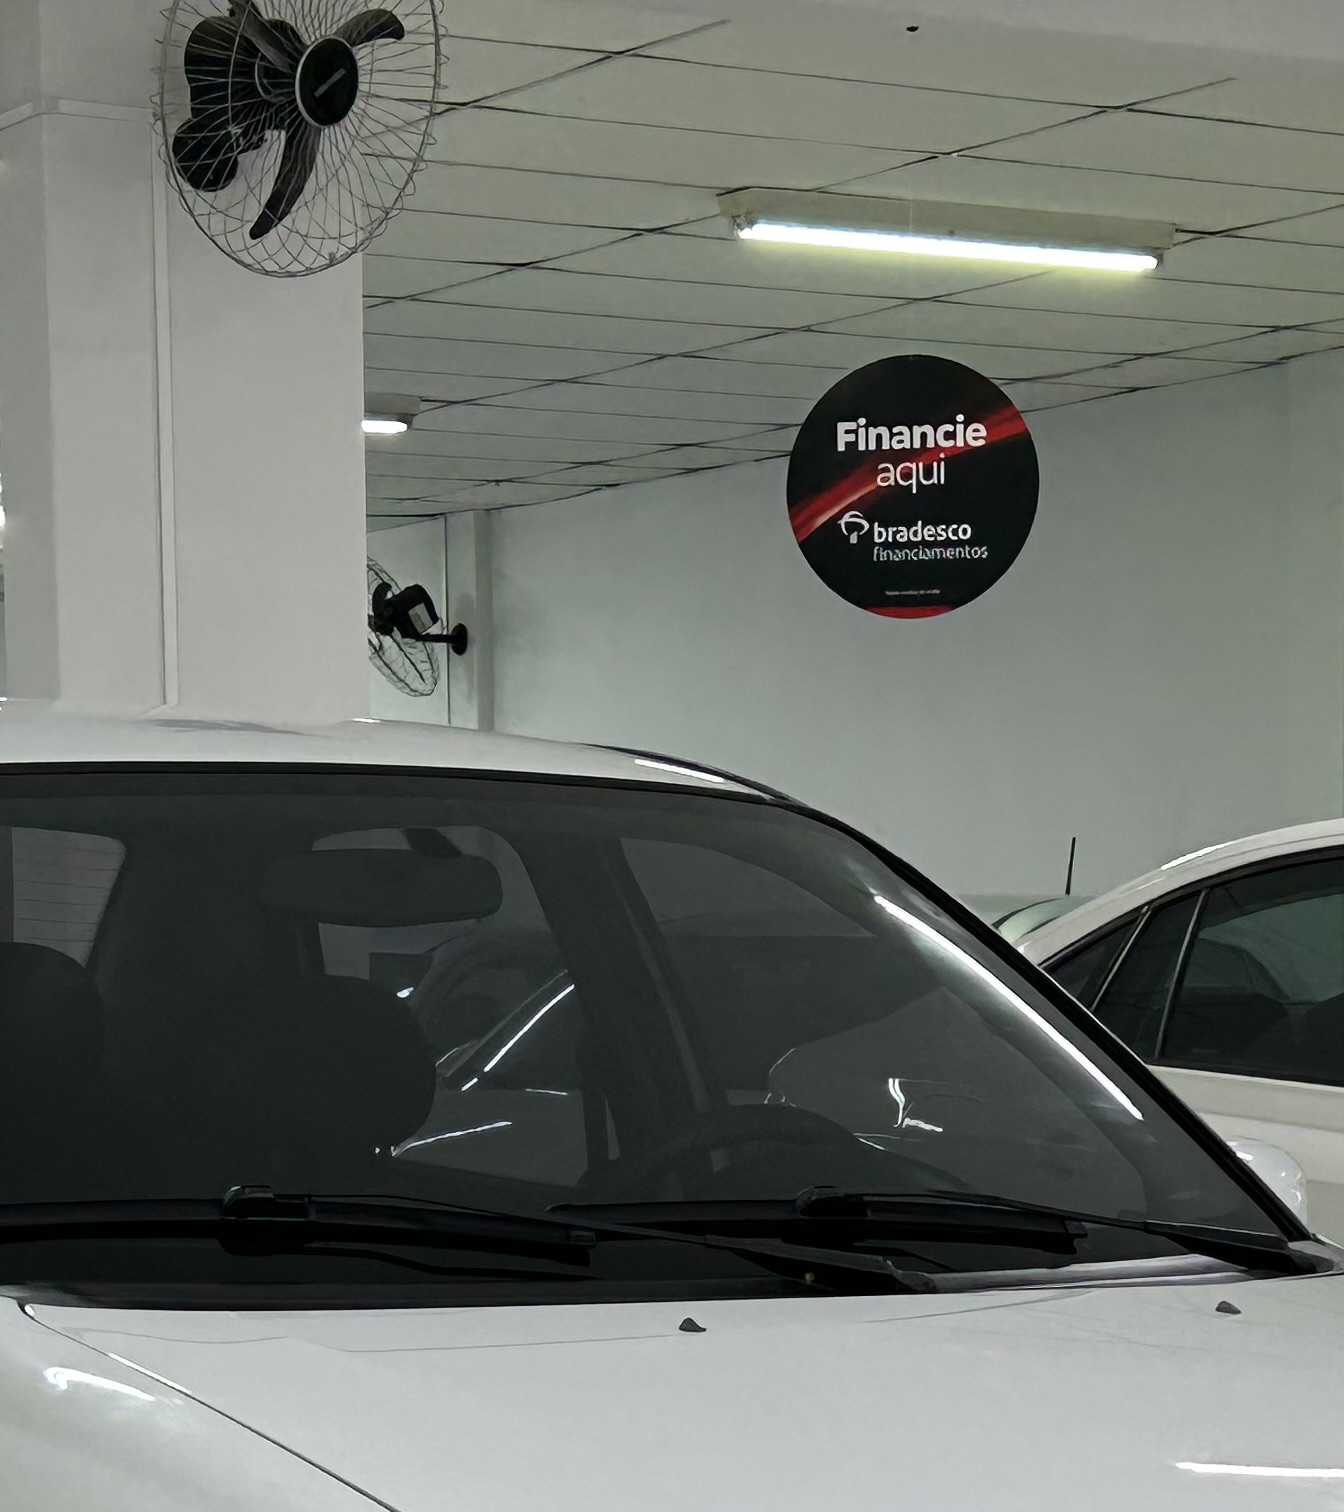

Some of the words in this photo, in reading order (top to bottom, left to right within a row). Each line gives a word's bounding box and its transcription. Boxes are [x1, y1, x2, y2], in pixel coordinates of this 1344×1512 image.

[836, 413, 987, 452] Financie
[876, 452, 945, 494] aqui
[873, 520, 972, 543] bradesco
[873, 544, 989, 562] financiamentos
